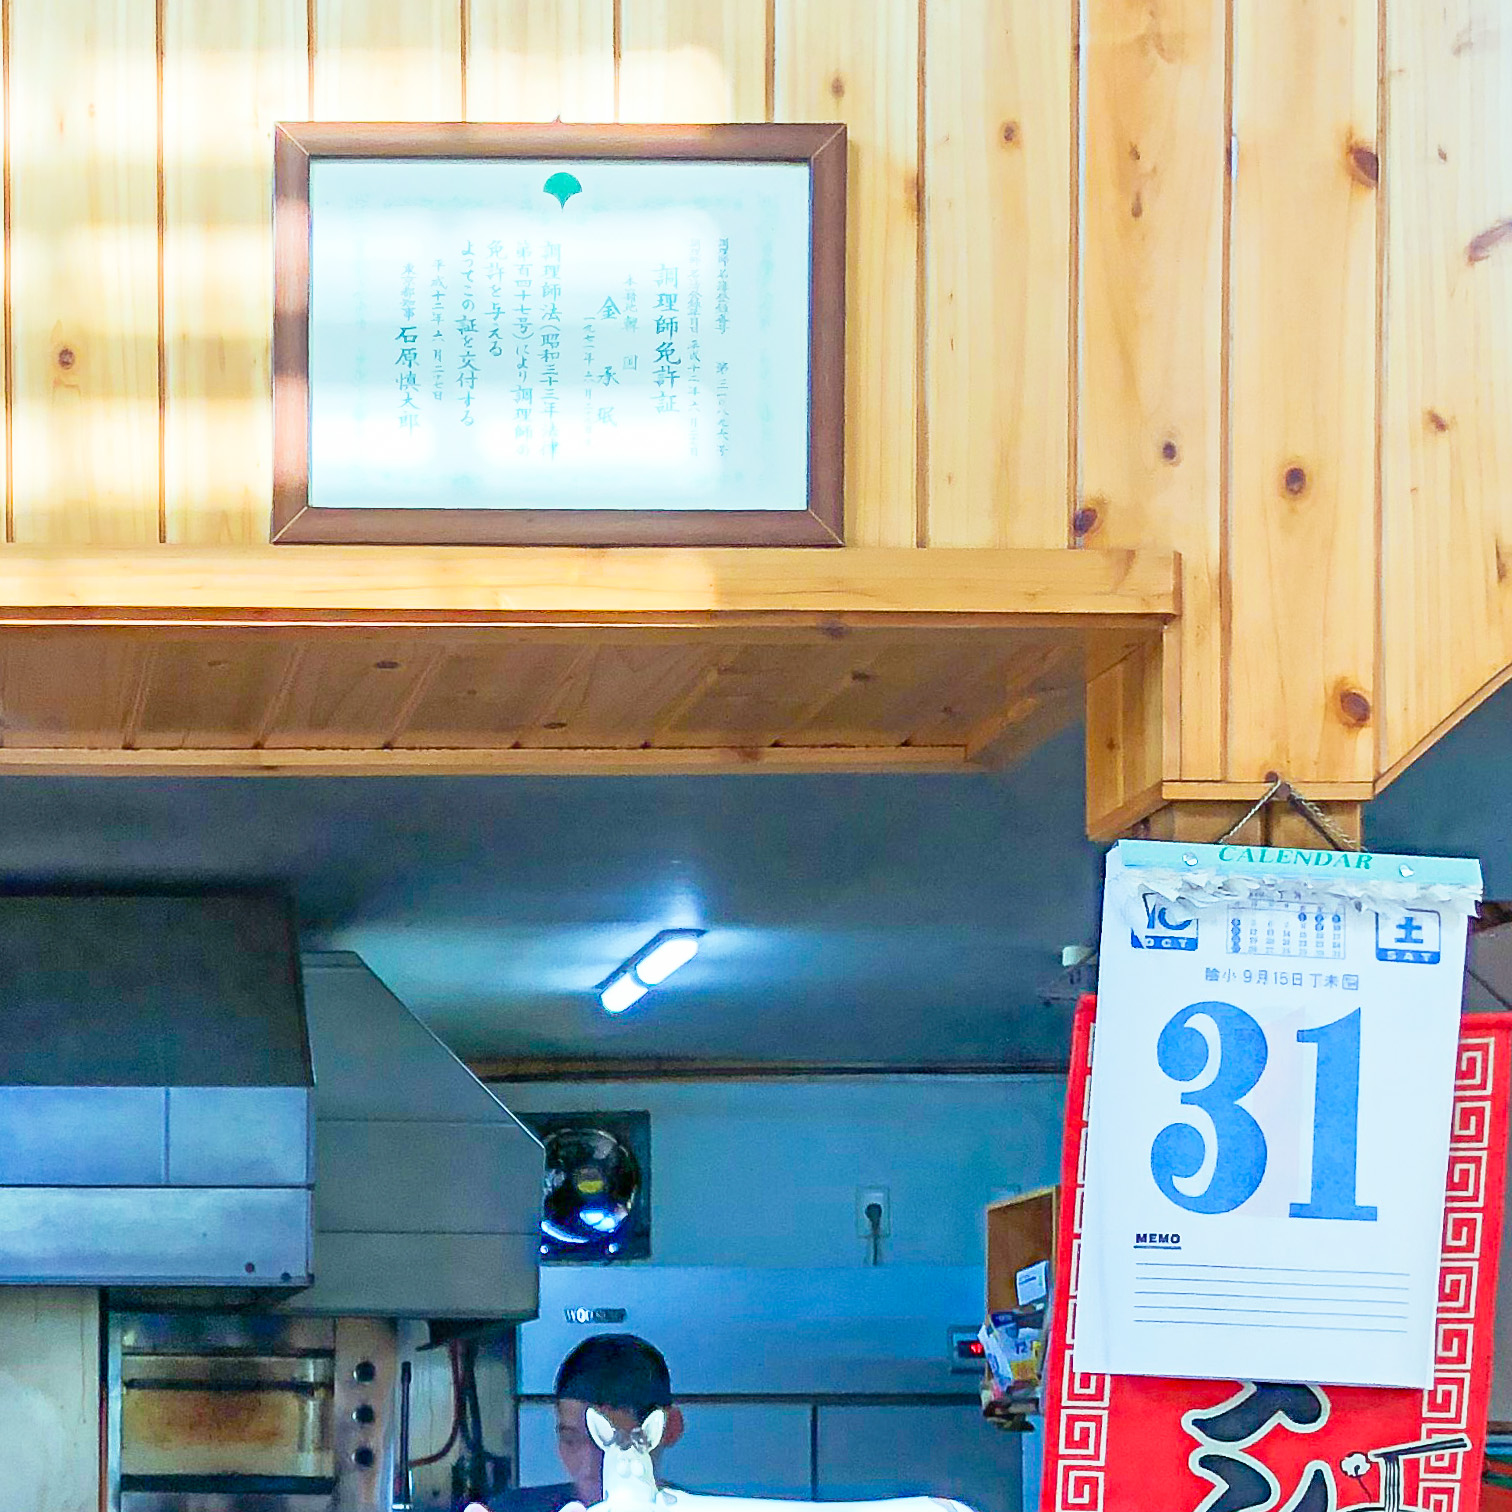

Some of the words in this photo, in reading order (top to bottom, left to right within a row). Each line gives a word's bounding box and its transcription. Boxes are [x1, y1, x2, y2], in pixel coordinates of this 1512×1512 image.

[484, 239, 507, 358] 免許を与える
[596, 295, 621, 320] 金
[454, 239, 481, 426] よってこの証を交付する
[650, 262, 682, 414] 調理師免許証
[1218, 845, 1374, 870] CALENDAR
[1394, 916, 1424, 943] 土
[1386, 950, 1431, 962] SAT
[1150, 1001, 1379, 1222] 31
[1134, 1232, 1181, 1244] MEMO
